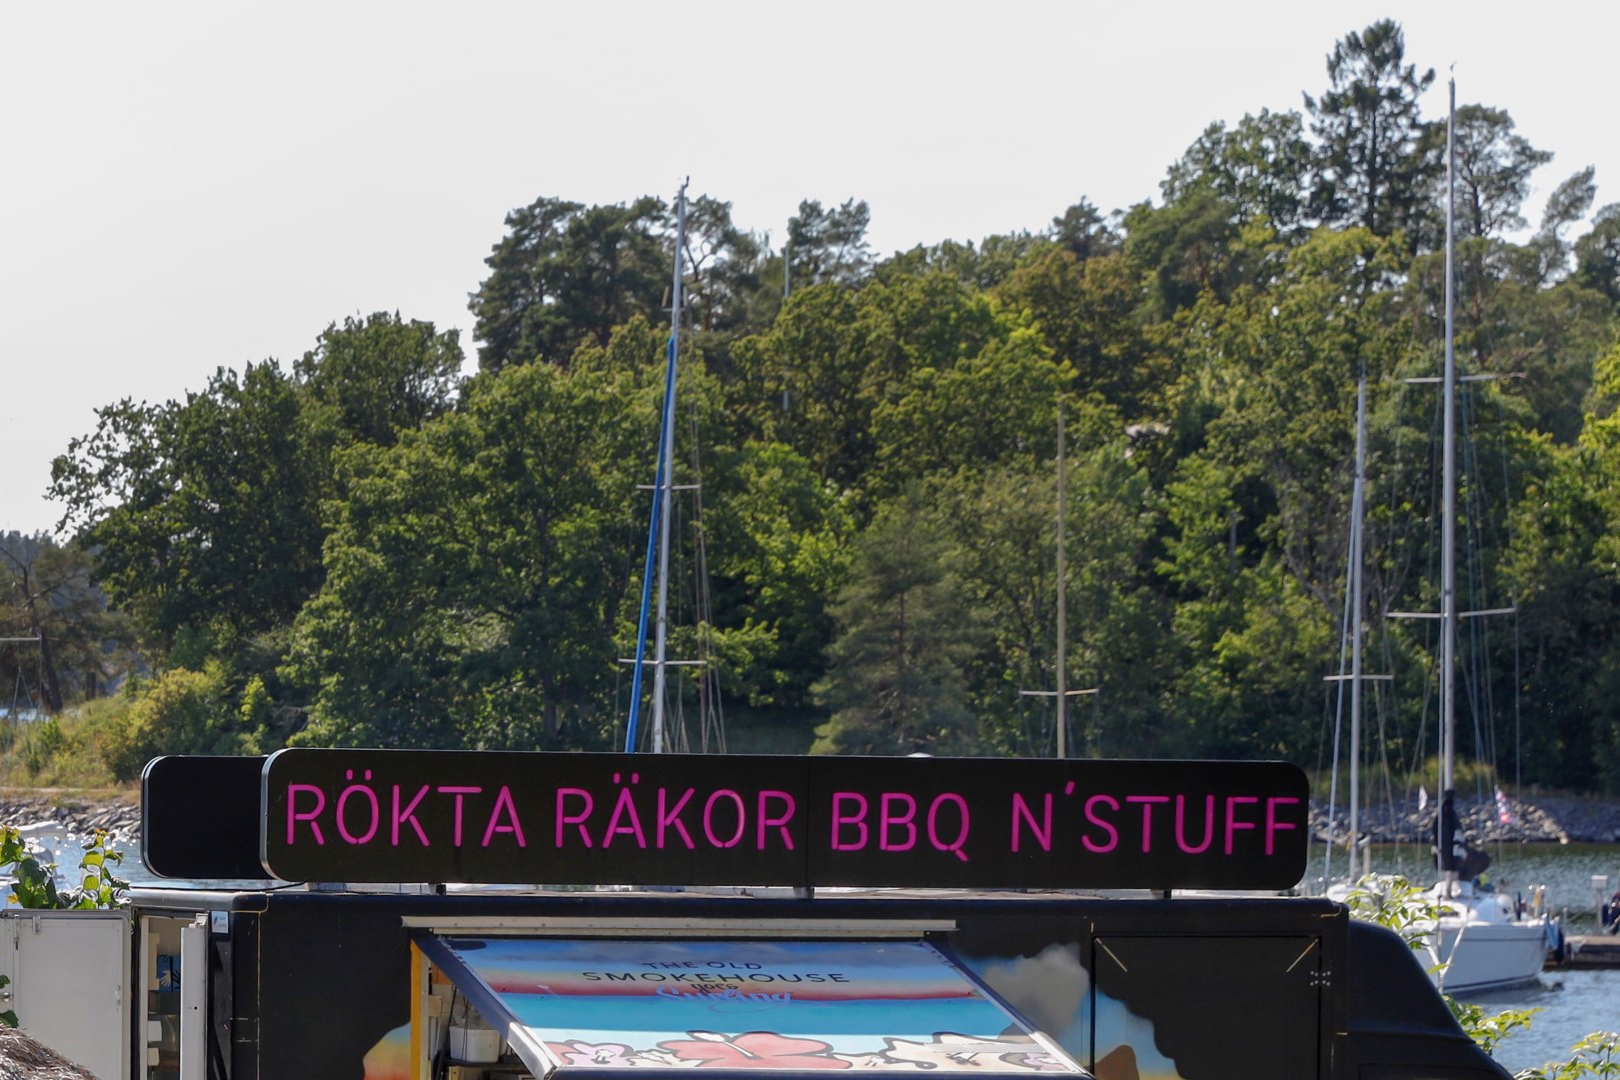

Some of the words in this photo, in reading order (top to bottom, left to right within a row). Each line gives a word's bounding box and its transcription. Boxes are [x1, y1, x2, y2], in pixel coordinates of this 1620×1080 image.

[287, 769, 527, 847] RÖKTA
[555, 773, 796, 850] RÄKOR
[830, 791, 971, 862] BBQ
[642, 961, 698, 970] THE
[707, 960, 763, 970] OLD
[582, 971, 851, 983] SMOKEHOUSE
